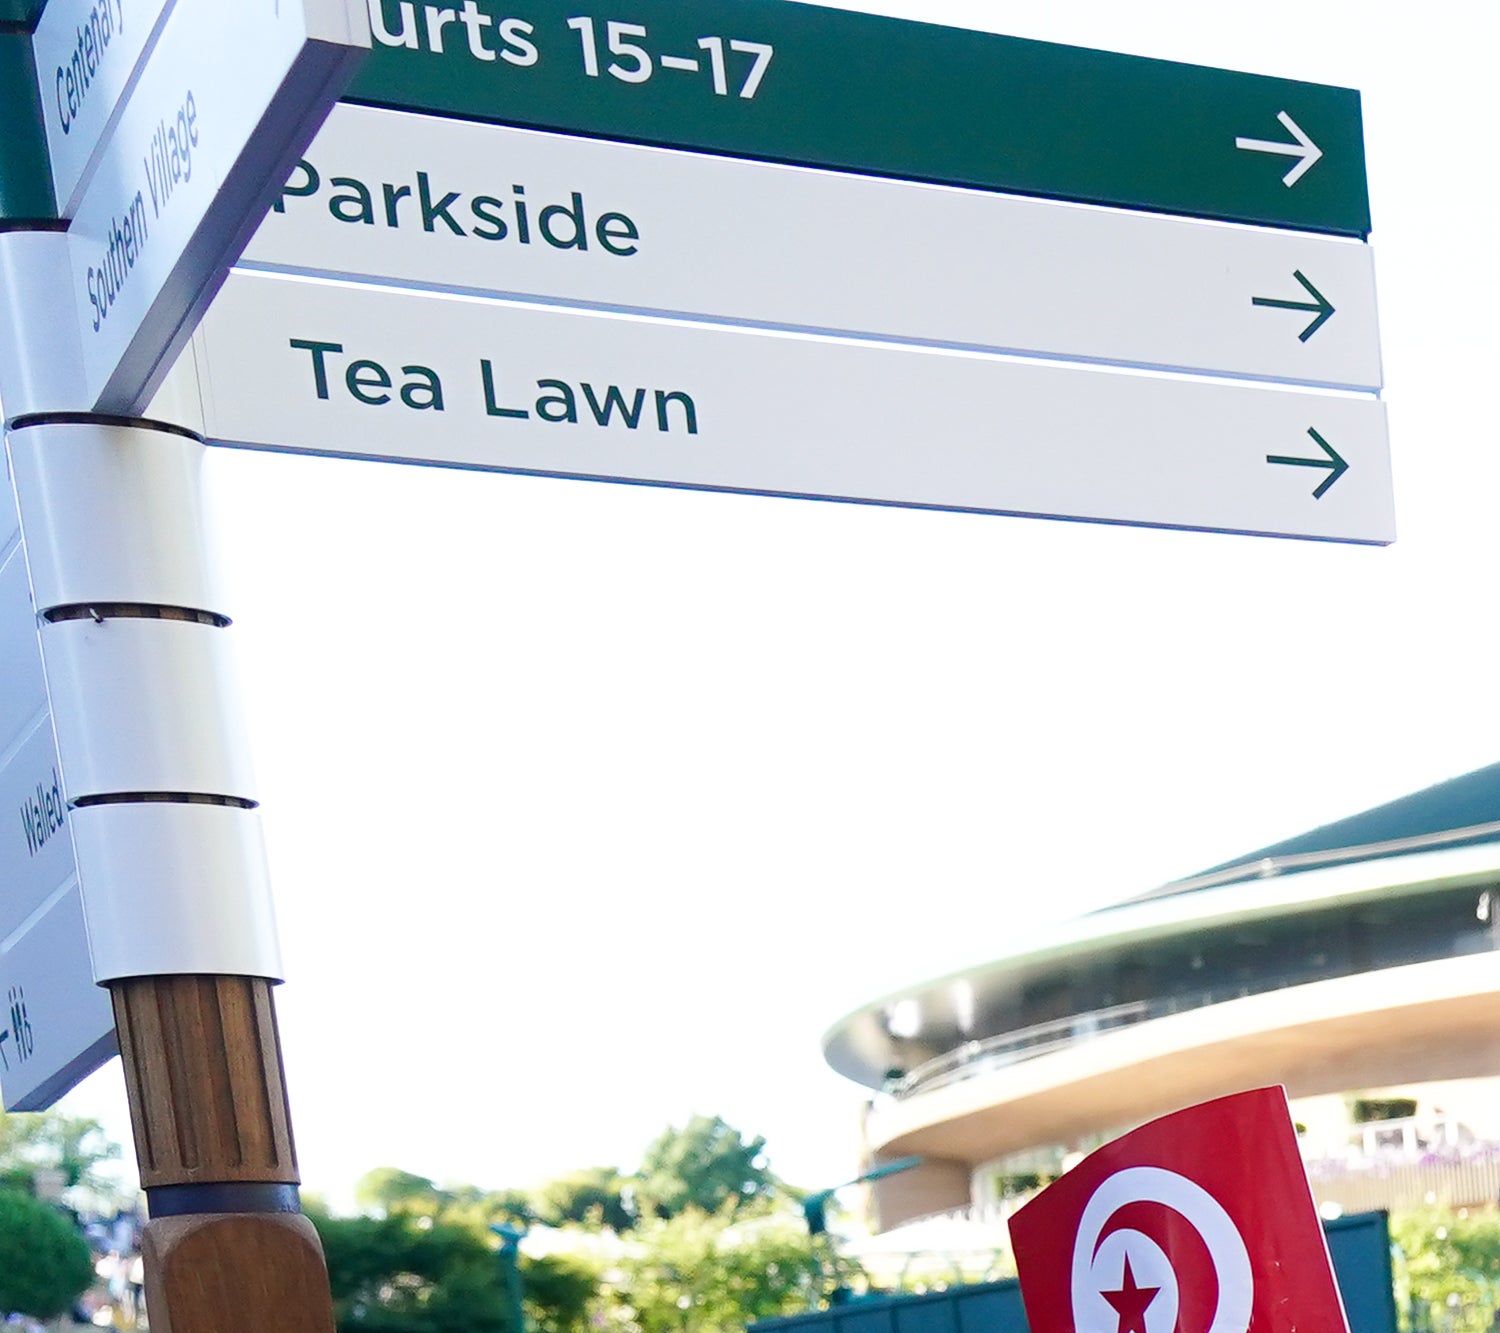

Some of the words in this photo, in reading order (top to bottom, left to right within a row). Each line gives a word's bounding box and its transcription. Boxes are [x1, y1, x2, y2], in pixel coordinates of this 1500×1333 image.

[369, 0, 538, 67] urts
[87, 190, 149, 332] Southern
[144, 90, 199, 219] Village
[273, 158, 640, 257] Parkside
[290, 338, 445, 411] Tea
[480, 359, 699, 435] Lawn
[20, 767, 64, 858] Walled
